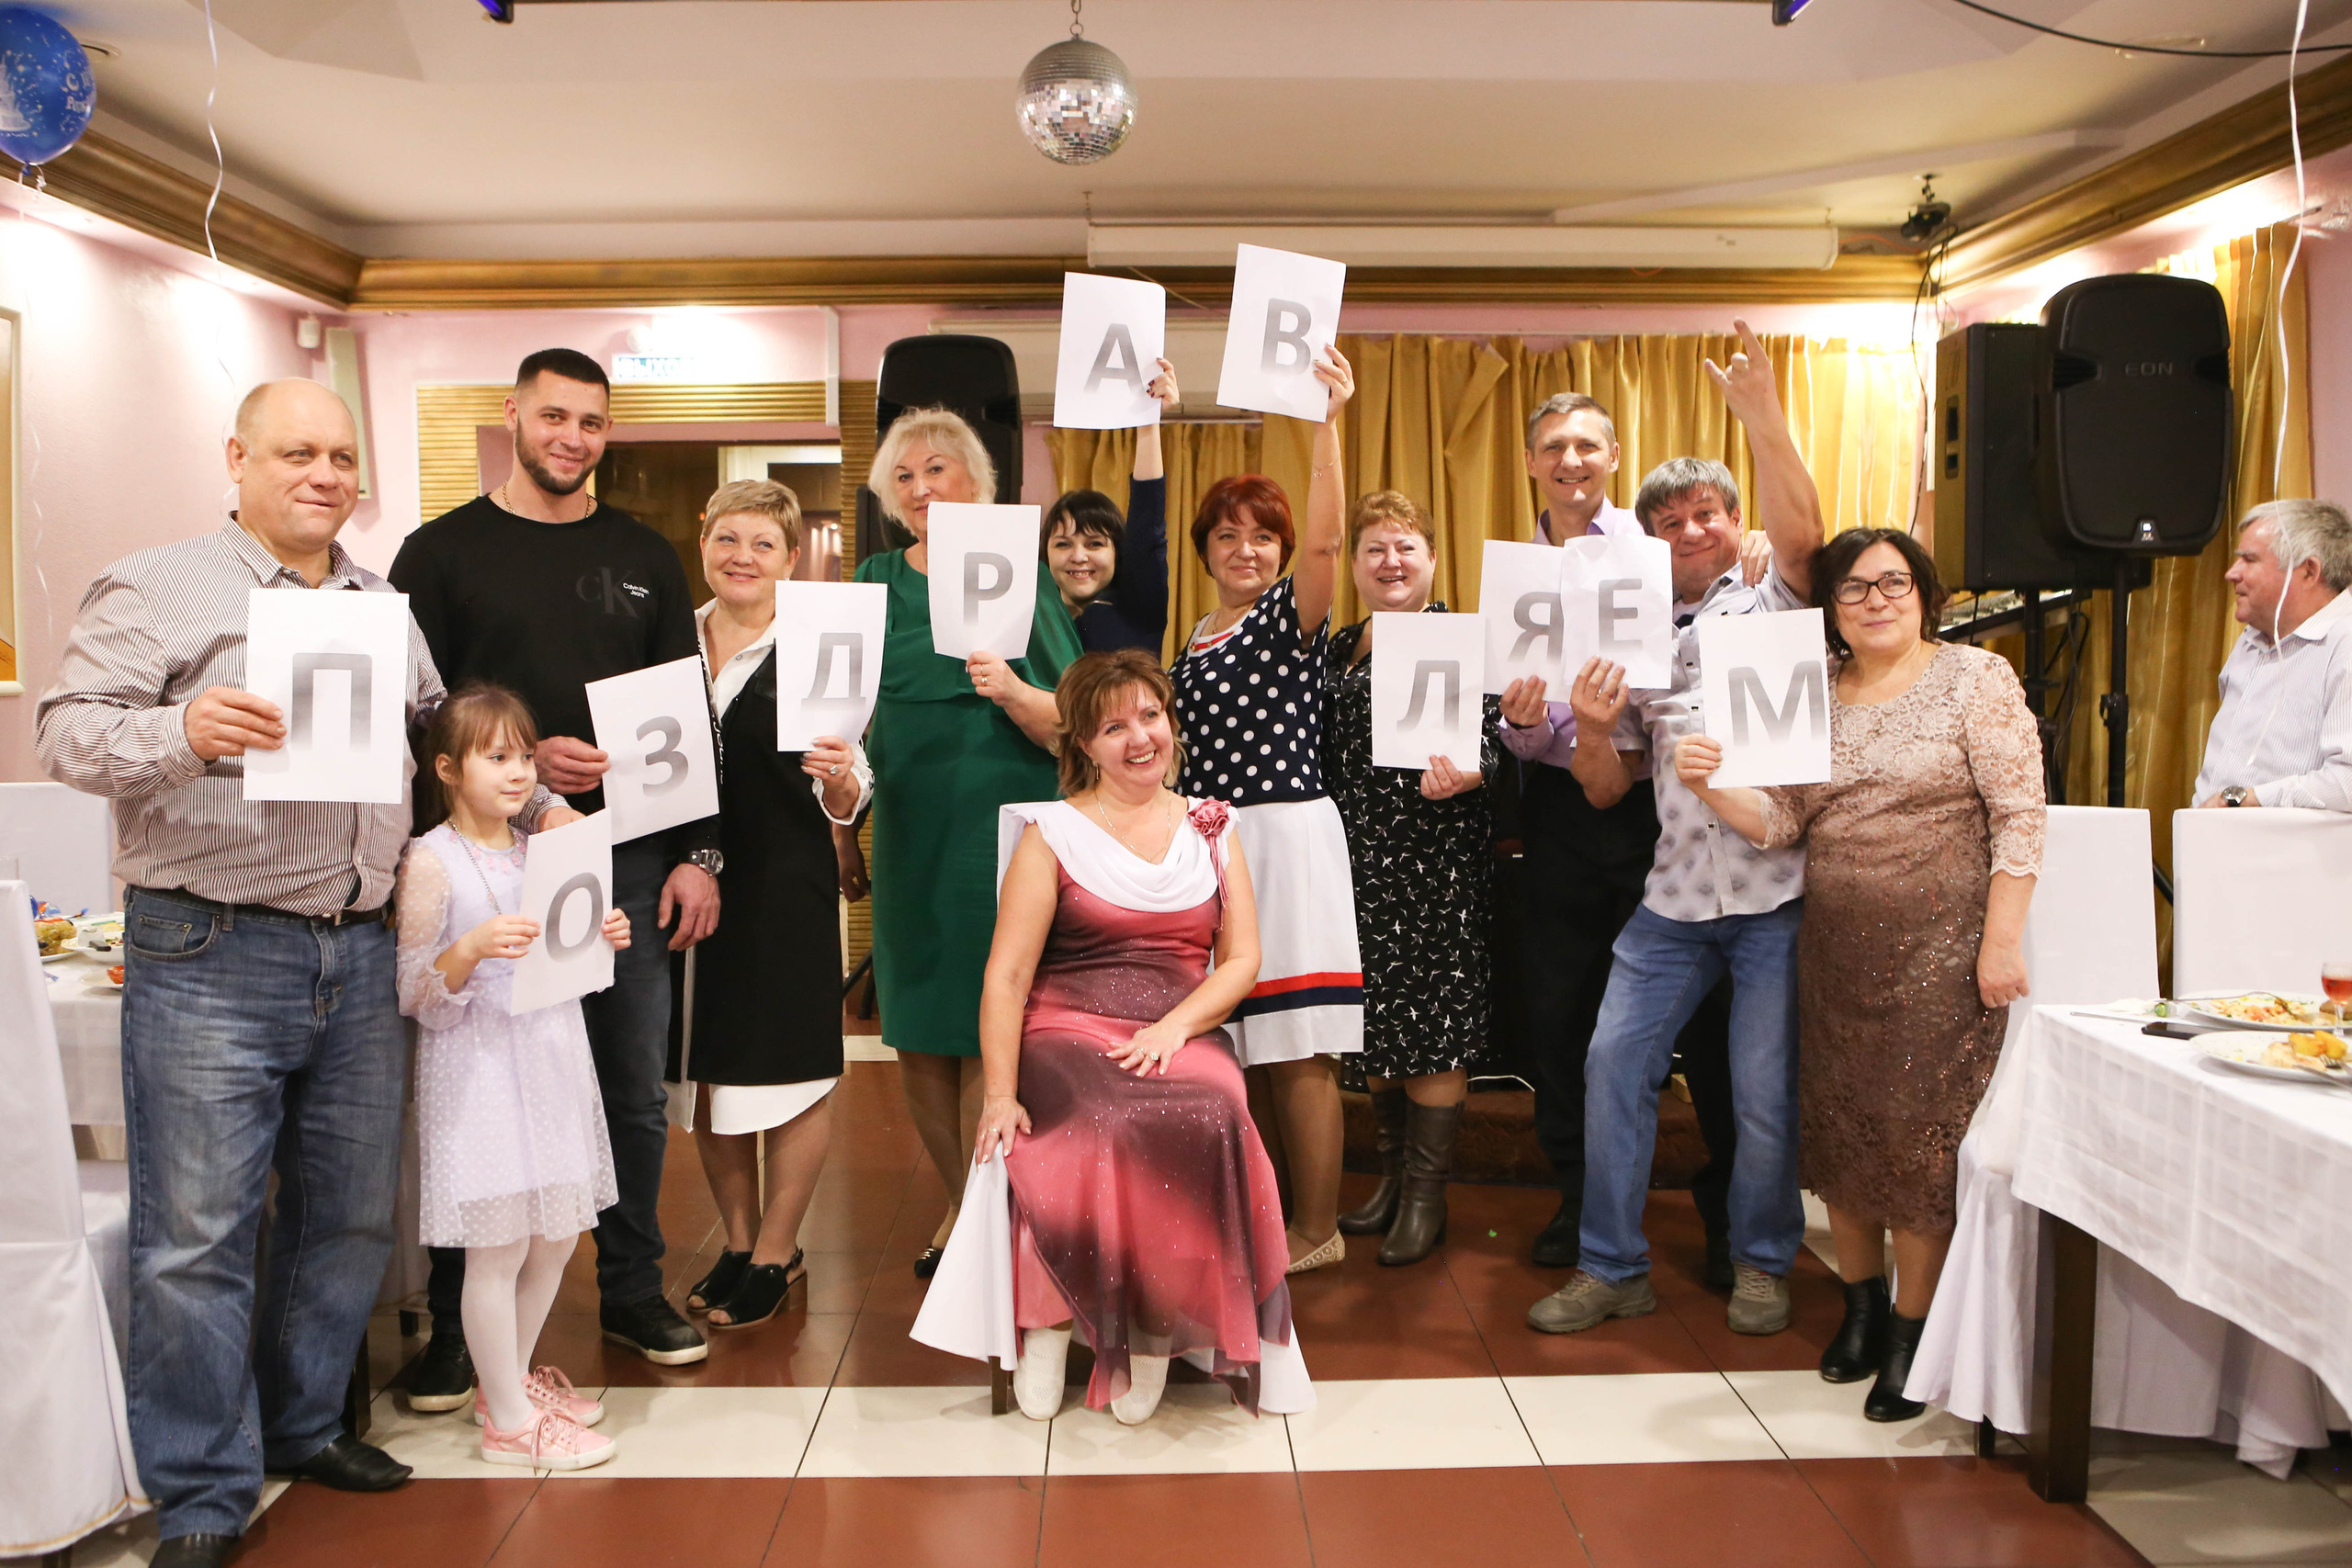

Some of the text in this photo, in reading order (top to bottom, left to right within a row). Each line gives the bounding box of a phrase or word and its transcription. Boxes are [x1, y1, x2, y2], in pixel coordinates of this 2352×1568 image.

[618, 357, 695, 378] ВЫХО
[1084, 323, 1147, 394] А
[1261, 298, 1313, 377] В
[2124, 361, 2174, 377] EON
[622, 582, 650, 595] Calvin Klein
[630, 590, 645, 599] Jeans
[963, 552, 1013, 626] Р
[1598, 578, 1644, 651] Е
[1508, 592, 1562, 665] Я
[291, 652, 373, 753] П
[800, 632, 866, 714] Д
[1396, 660, 1461, 734] Л
[1727, 660, 1827, 747] М
[636, 715, 689, 797] З
[545, 872, 604, 964] О
